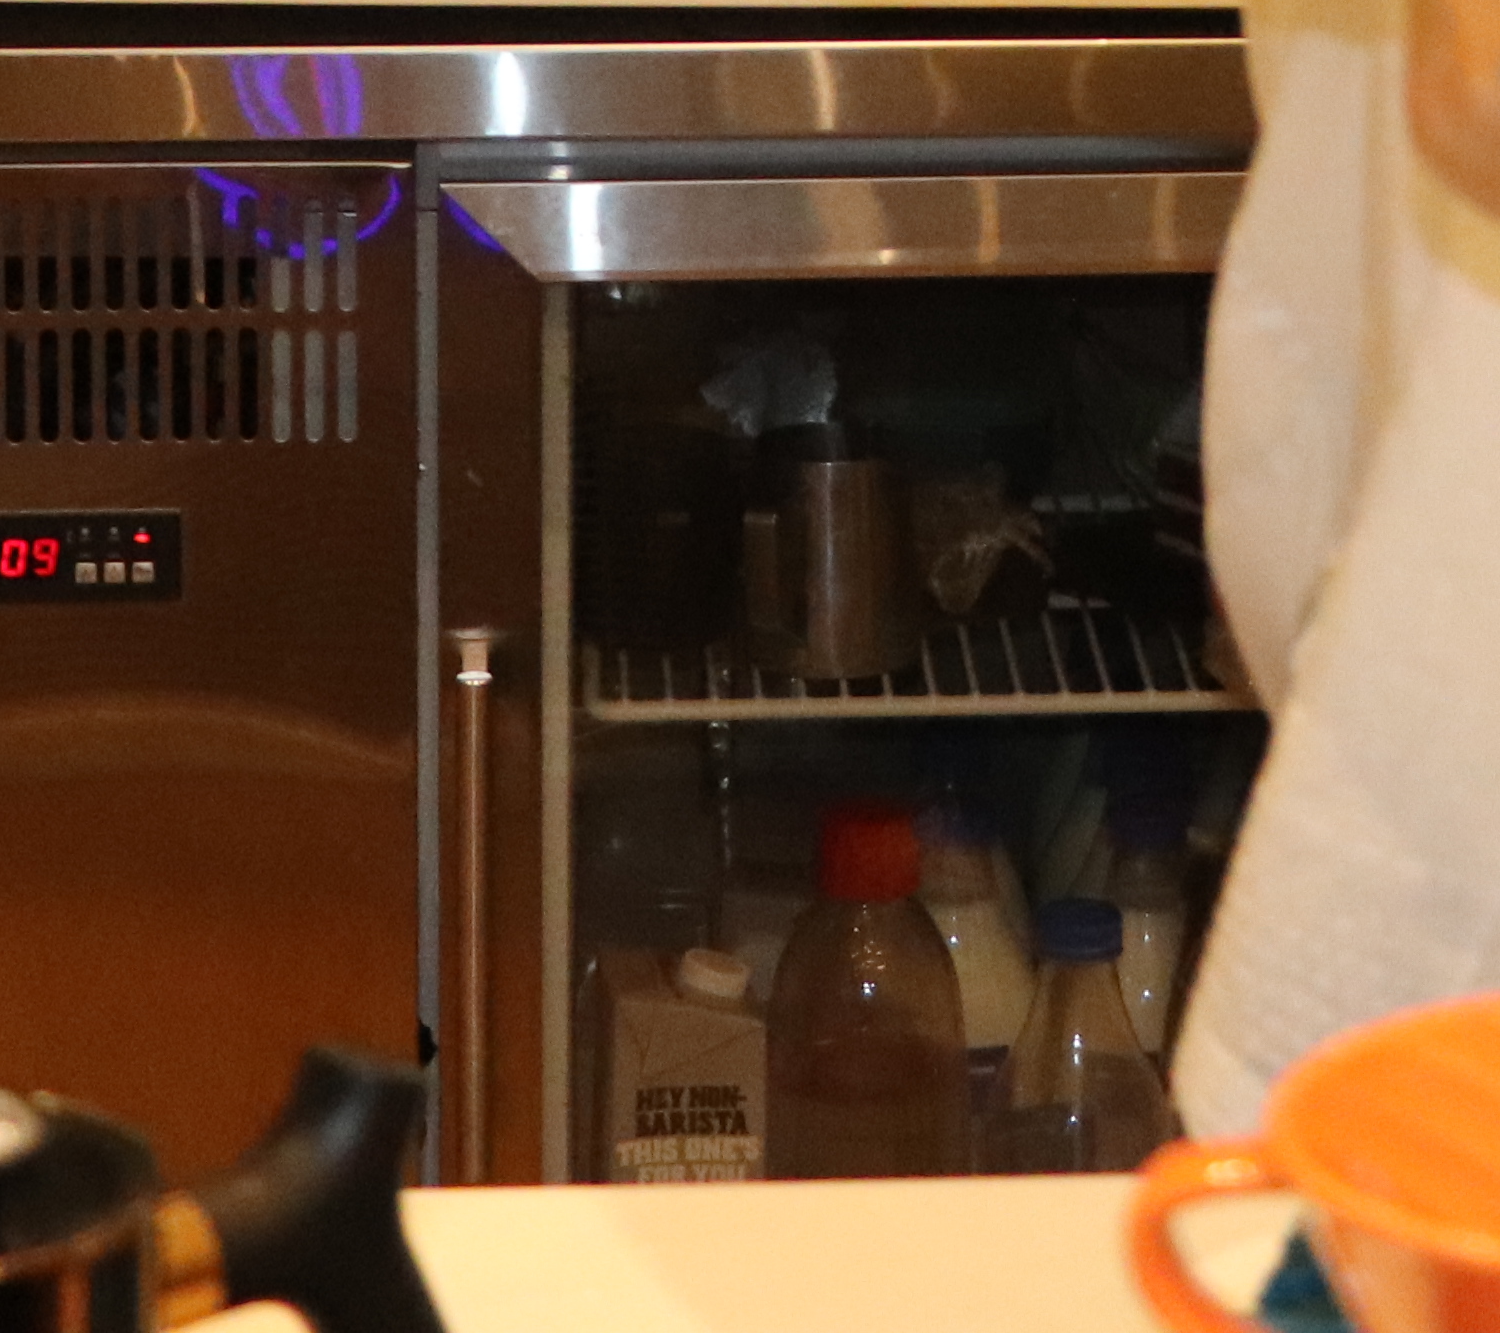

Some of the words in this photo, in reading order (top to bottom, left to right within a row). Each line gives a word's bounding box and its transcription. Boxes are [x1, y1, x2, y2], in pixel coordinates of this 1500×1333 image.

[0, 537, 61, 578] 09
[635, 1087, 684, 1111] HEY
[688, 1084, 747, 1109] NON-
[635, 1110, 750, 1137] BARISTA
[615, 1138, 679, 1168] THIS
[684, 1134, 763, 1162] ONE'S
